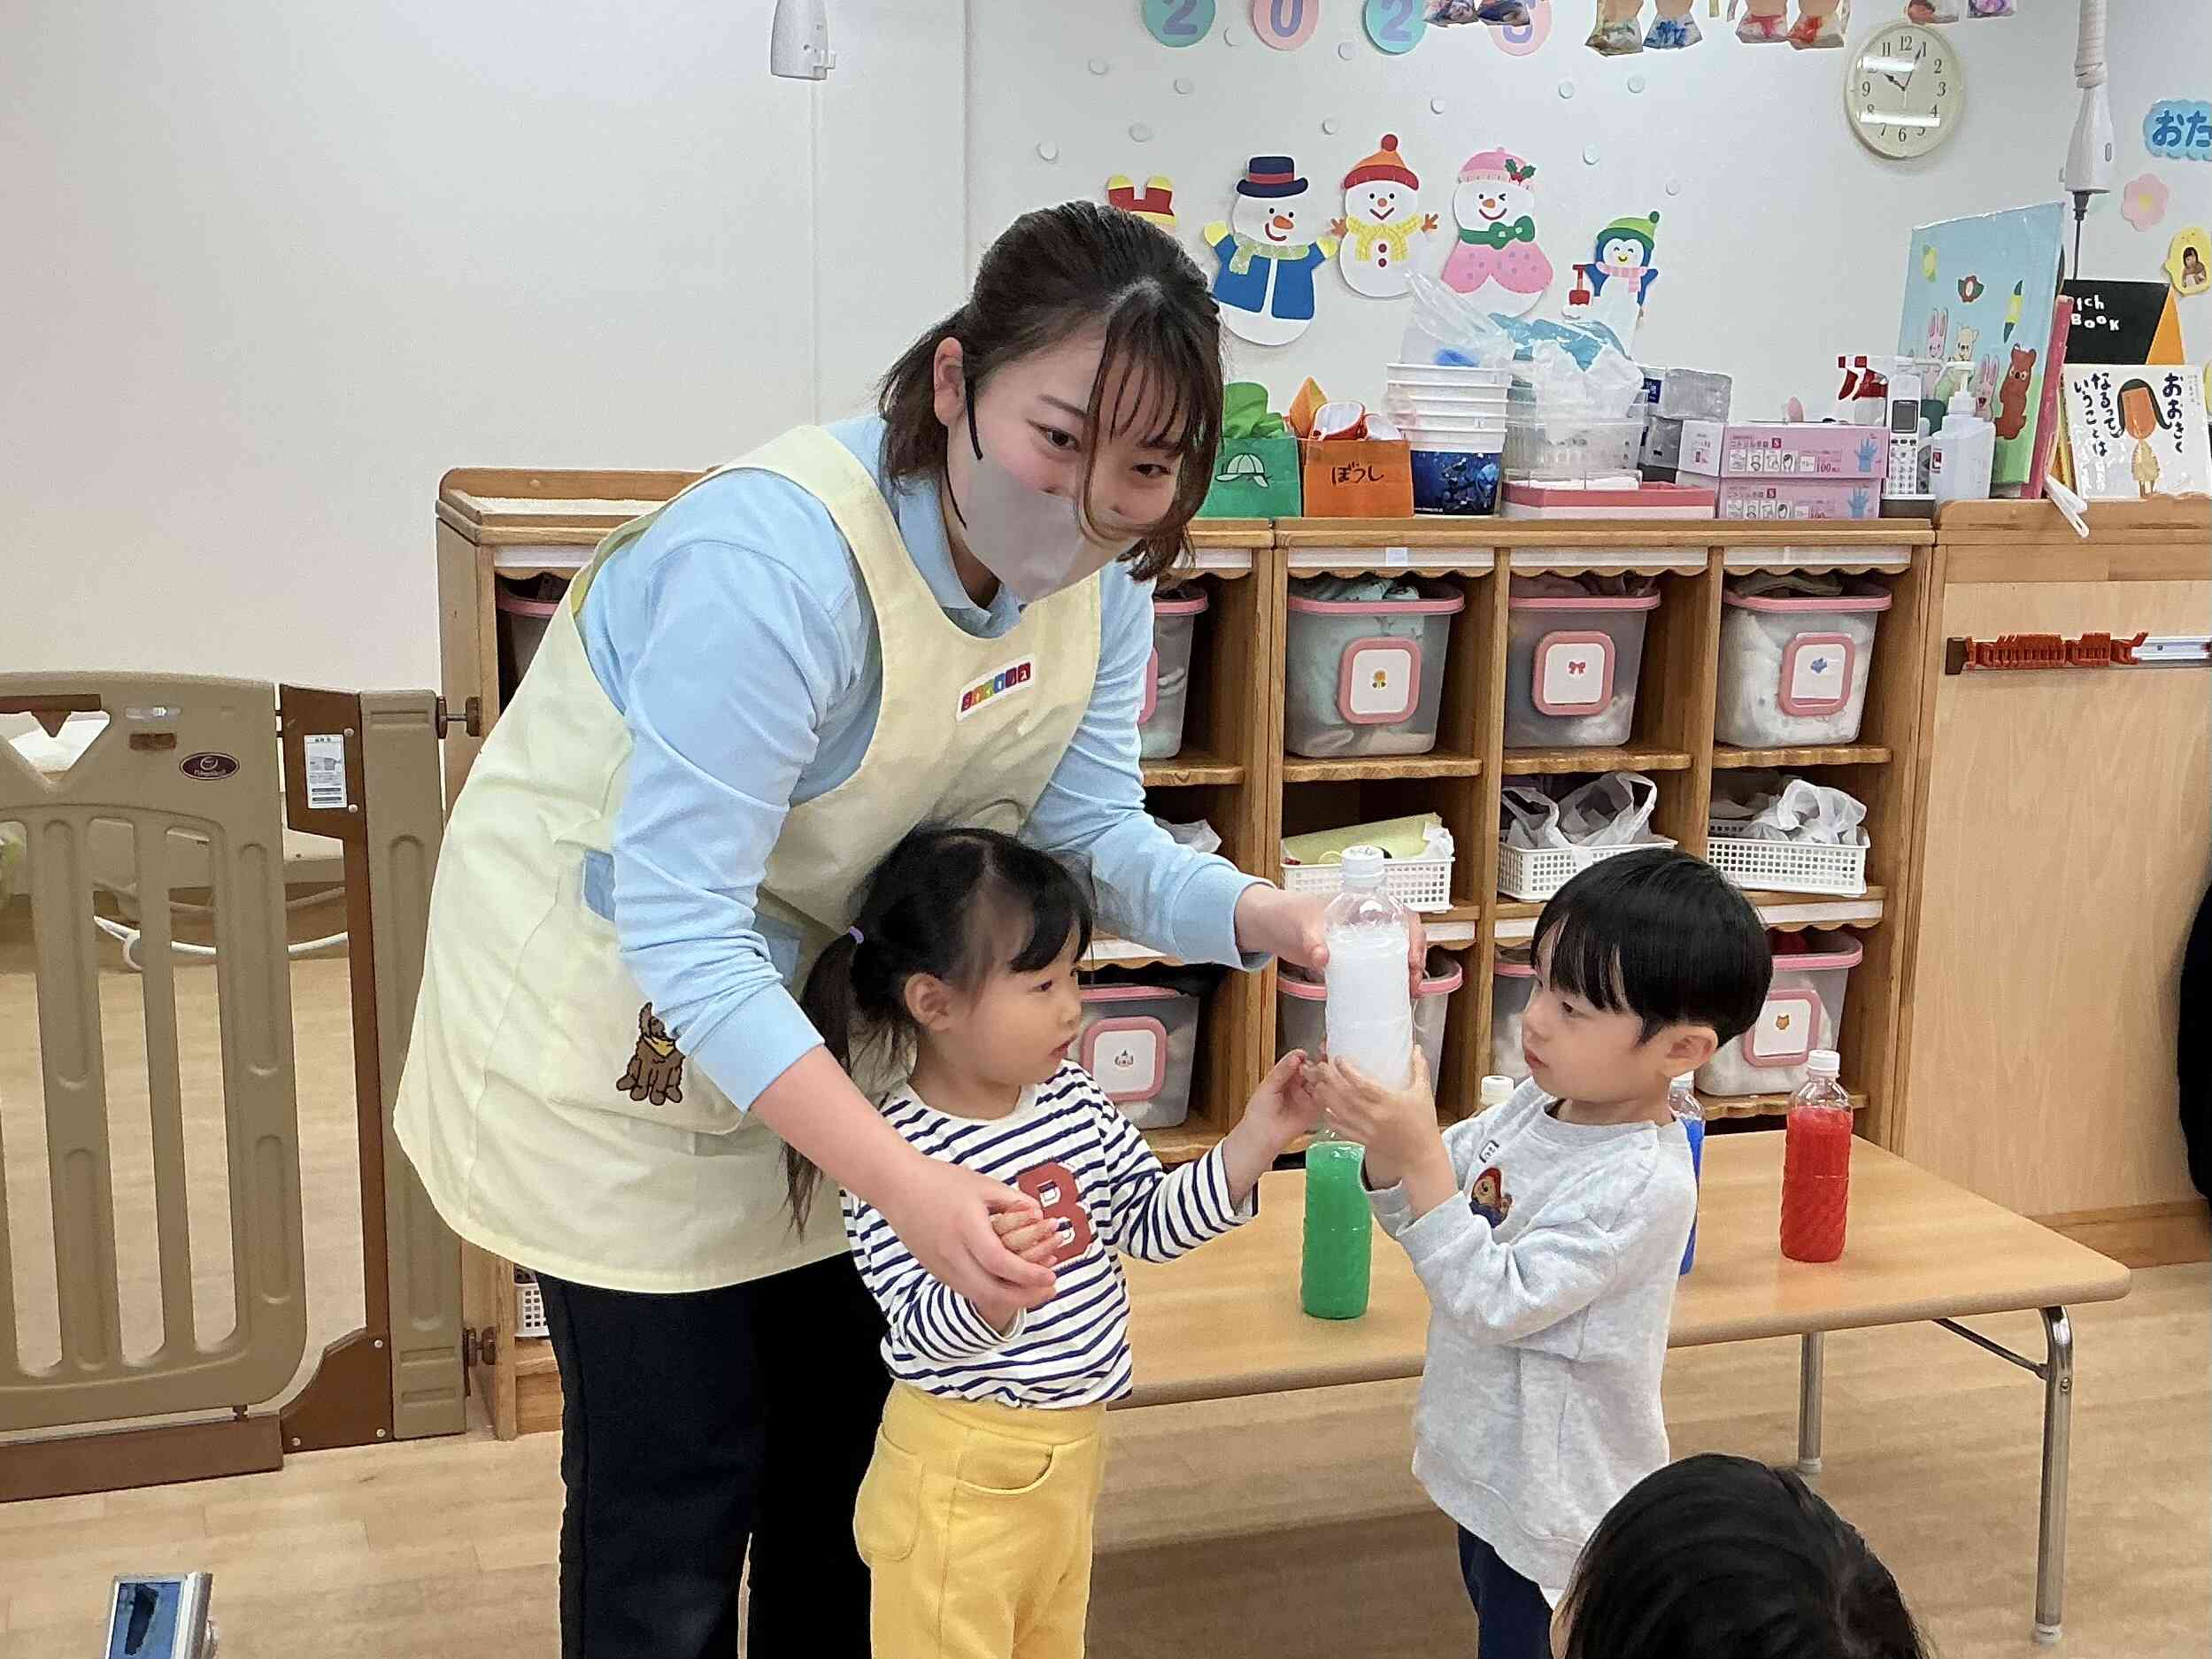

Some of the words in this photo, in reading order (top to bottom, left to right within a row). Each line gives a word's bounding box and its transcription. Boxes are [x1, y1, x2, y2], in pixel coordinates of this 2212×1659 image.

[1882, 42, 1891, 57] 11
[1900, 35, 1912, 50] 12
[1922, 42, 1927, 57] 1
[1934, 58, 1942, 73] 2
[1861, 81, 1871, 96] 9
[1937, 81, 1946, 96] 3
[1930, 104, 1938, 117] 4
[1899, 127, 1907, 142] 6
[2153, 110, 2212, 147] おた
[2091, 372, 2117, 430] なるって
[2074, 379, 2108, 457] いうことは
[2162, 372, 2184, 453] おおきく
[1331, 461, 1384, 485] ぼうし
[1018, 1161, 1092, 1264] B
